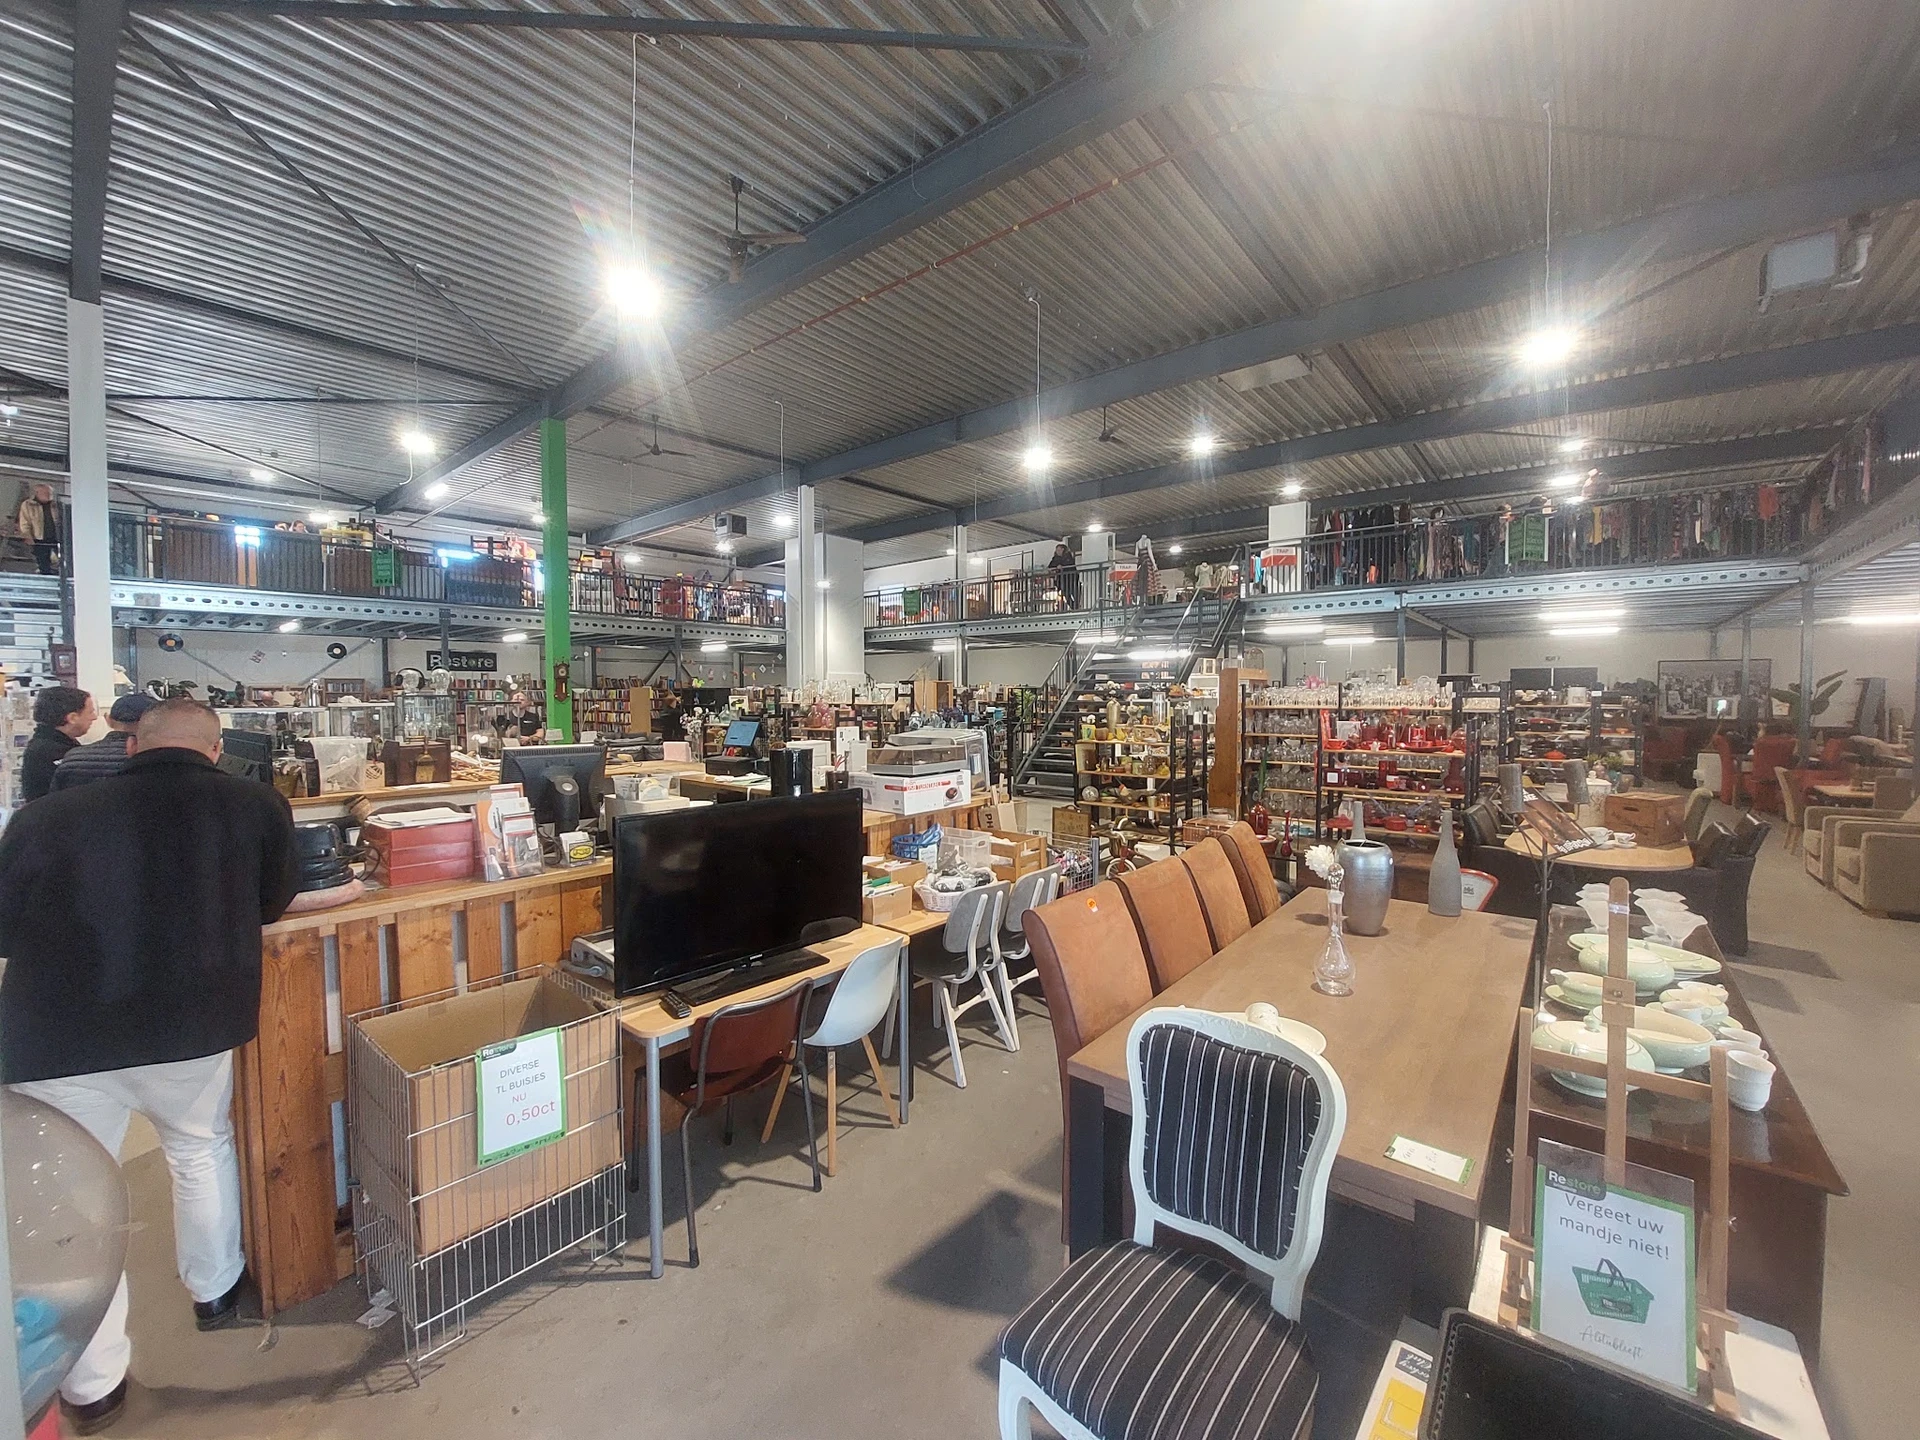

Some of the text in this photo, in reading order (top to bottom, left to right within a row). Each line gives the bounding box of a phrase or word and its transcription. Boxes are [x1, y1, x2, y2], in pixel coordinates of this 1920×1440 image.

[430, 654, 494, 668] Rstore
[499, 1059, 540, 1079] DIVERSE
[496, 1072, 546, 1094] TL BUISJES
[512, 1092, 526, 1103] NU
[505, 1101, 556, 1126] 0,50ct
[1548, 1170, 1601, 1195] Restore
[1565, 1193, 1664, 1234] Vergeet uw
[1560, 1216, 1669, 1260] mandje niet!
